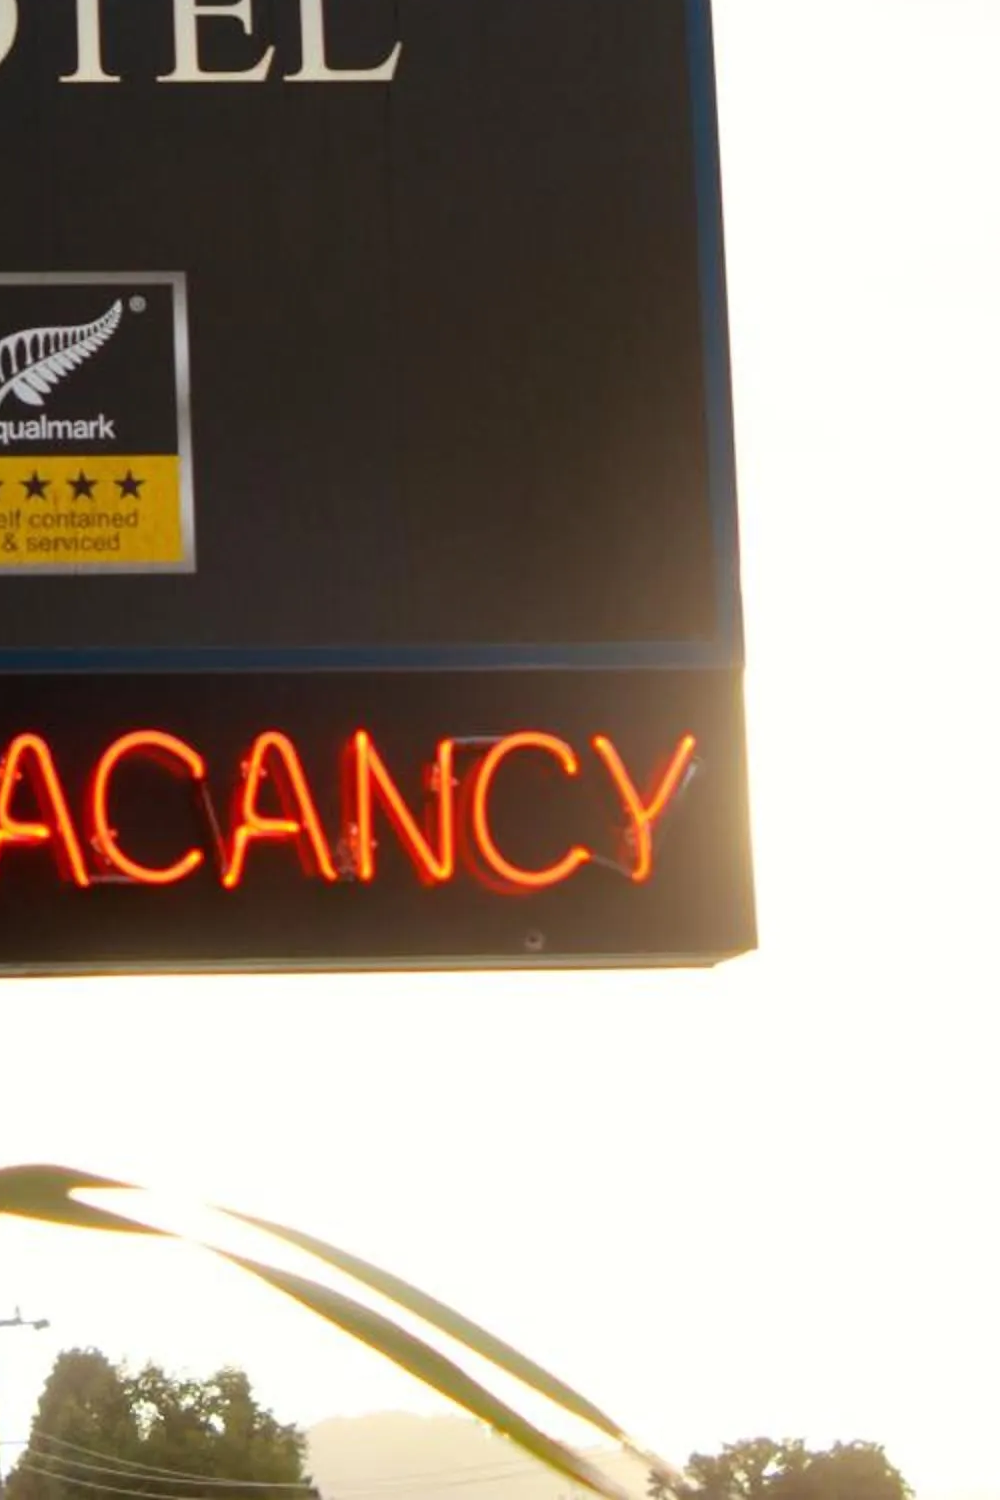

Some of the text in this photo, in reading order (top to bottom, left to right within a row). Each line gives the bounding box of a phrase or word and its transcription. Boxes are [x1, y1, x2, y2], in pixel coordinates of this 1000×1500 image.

[28, 509, 139, 529] contained
[1, 532, 121, 552] & serviced
